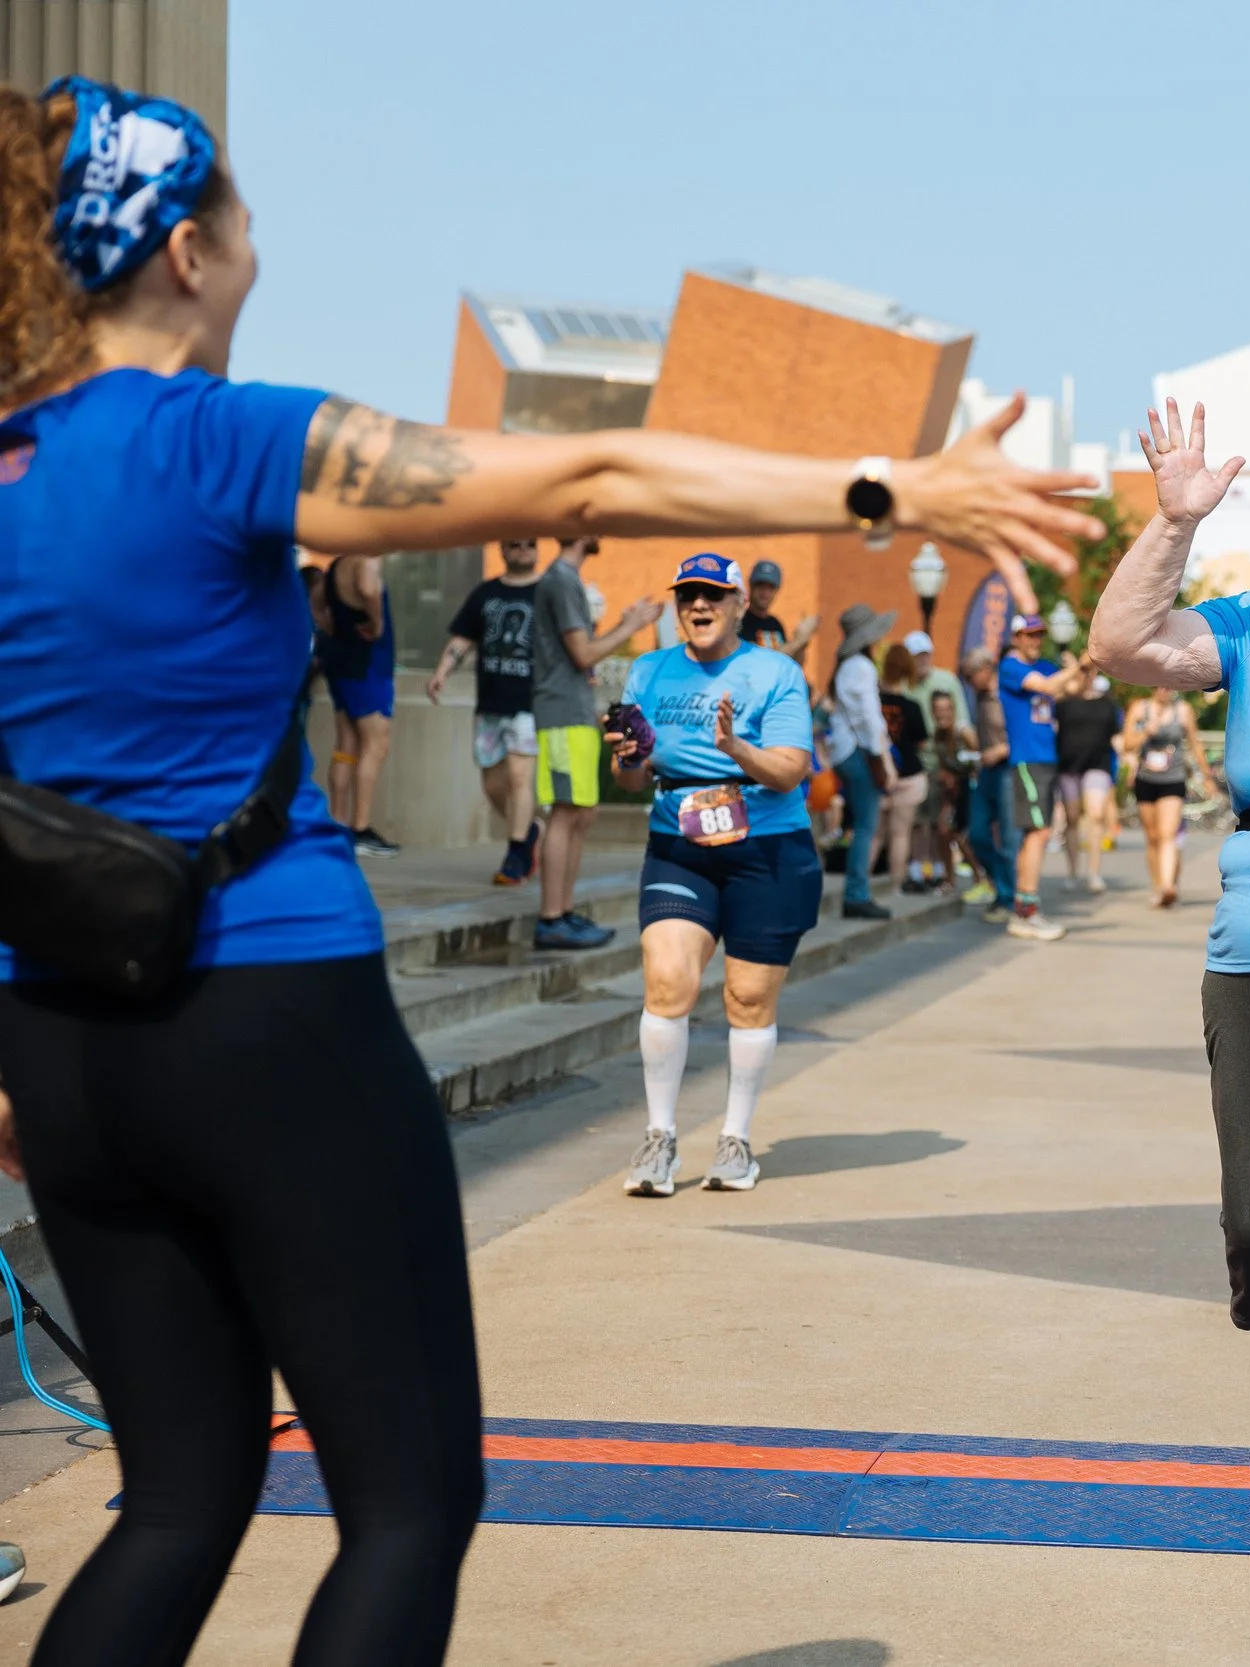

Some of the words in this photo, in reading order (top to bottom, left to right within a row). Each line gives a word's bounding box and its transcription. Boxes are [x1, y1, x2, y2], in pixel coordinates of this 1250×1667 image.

[654, 709, 717, 727] runnin
[710, 697, 747, 719] cy
[699, 805, 734, 835] 88
